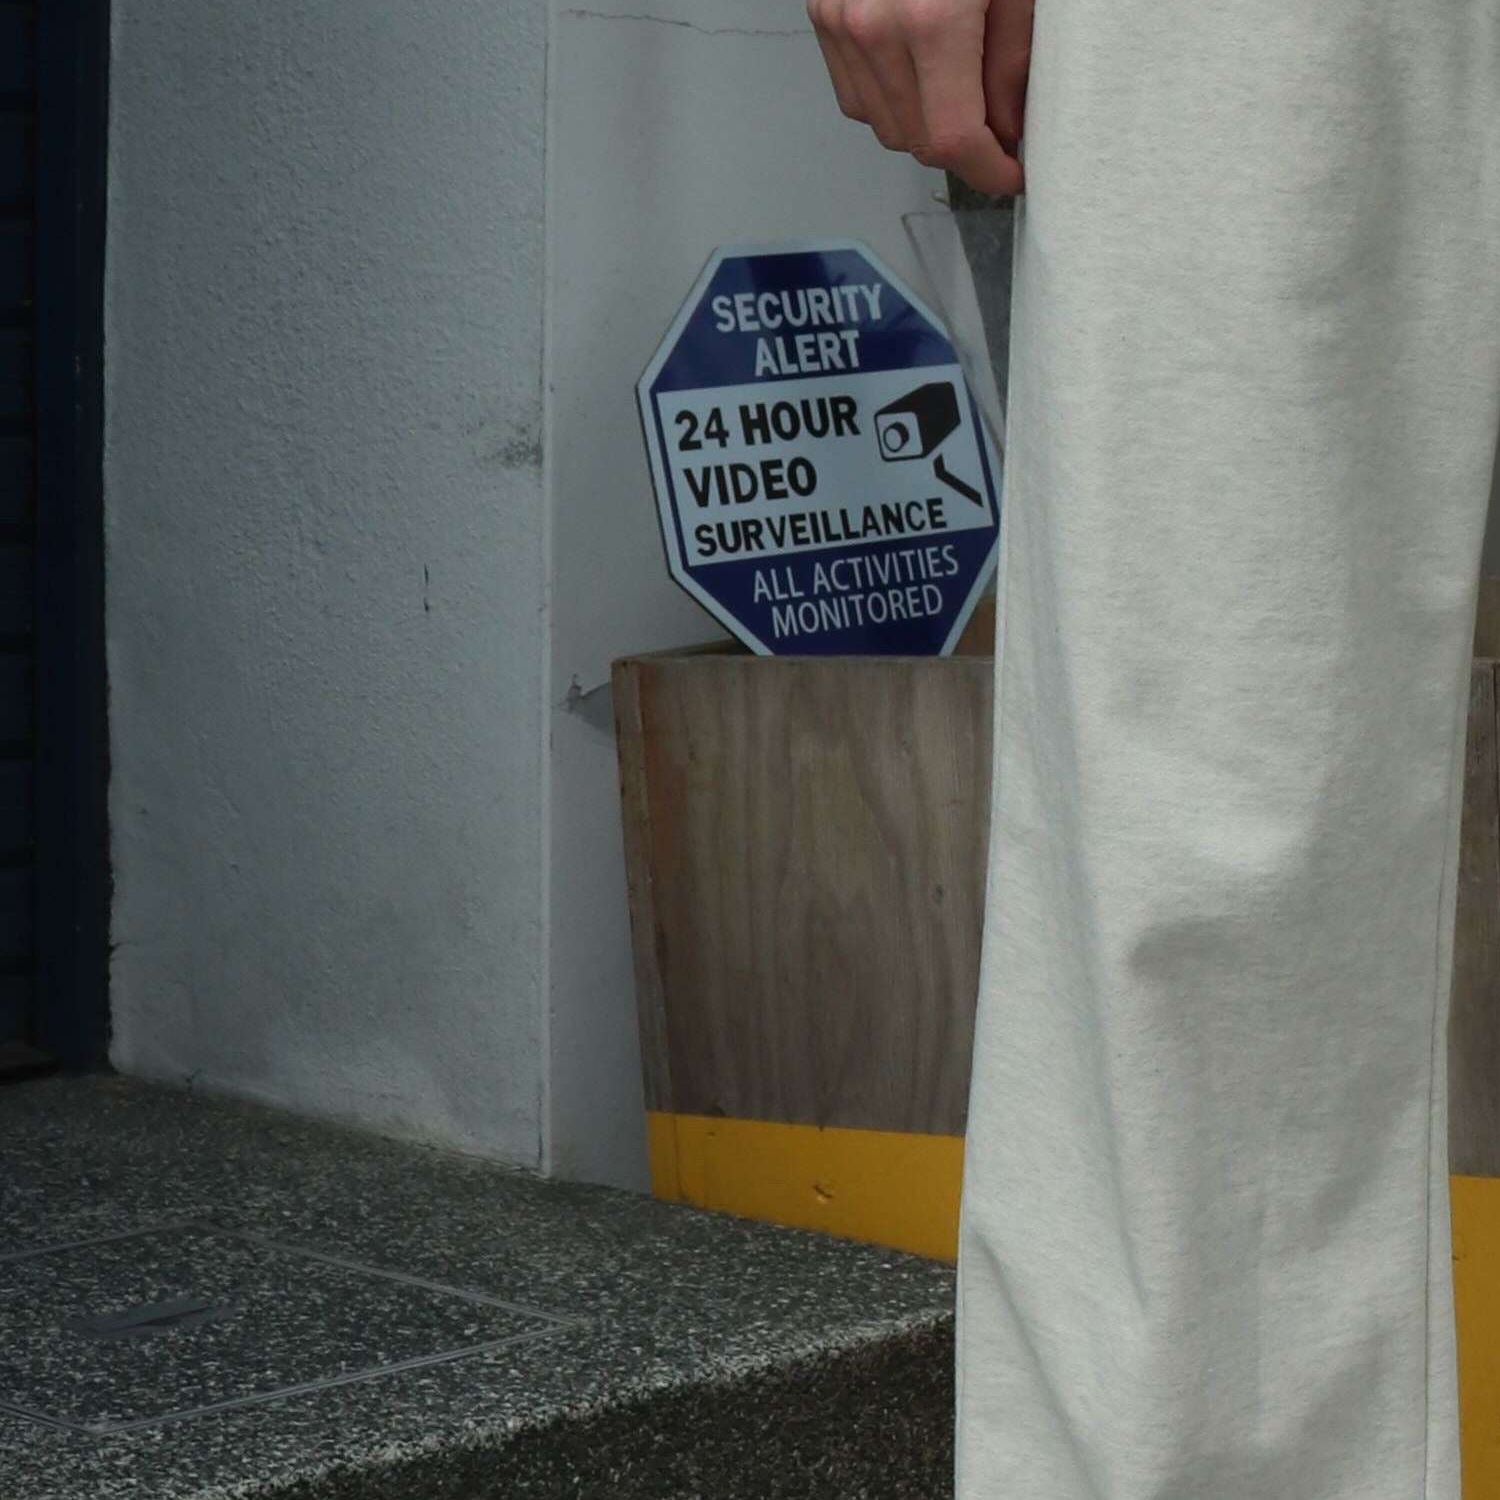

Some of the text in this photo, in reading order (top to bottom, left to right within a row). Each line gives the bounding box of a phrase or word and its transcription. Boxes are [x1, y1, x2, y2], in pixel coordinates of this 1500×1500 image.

[711, 283, 882, 333] SECURITY
[754, 330, 860, 377] ALERT
[674, 395, 861, 451] 24 HOUR
[683, 456, 817, 508] VIDEO
[694, 497, 948, 558] SURVEILLANCE
[753, 544, 959, 603] ALL ACTIVITIES
[771, 584, 943, 638] MONITORED
